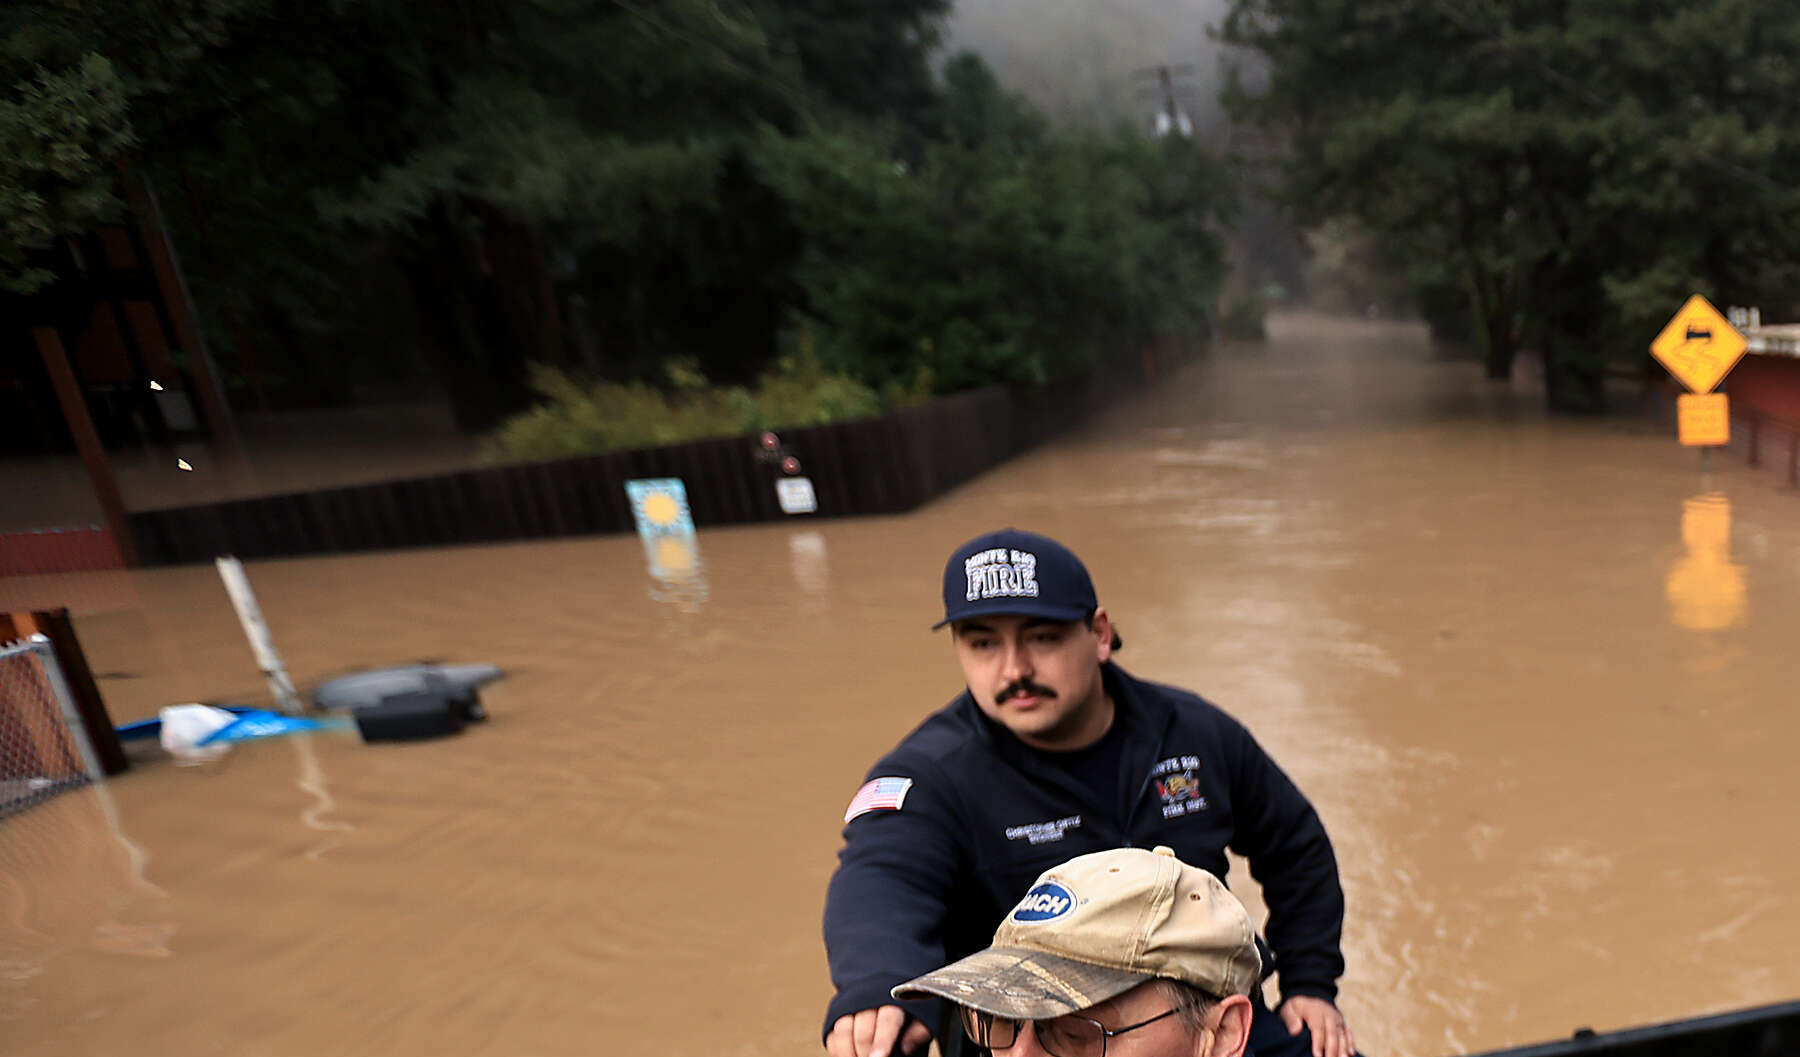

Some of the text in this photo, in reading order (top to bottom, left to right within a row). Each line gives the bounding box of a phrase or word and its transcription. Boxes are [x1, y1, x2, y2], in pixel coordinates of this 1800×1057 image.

[964, 548, 1037, 570] MONTE RIO
[966, 562, 1040, 602] FIRE
